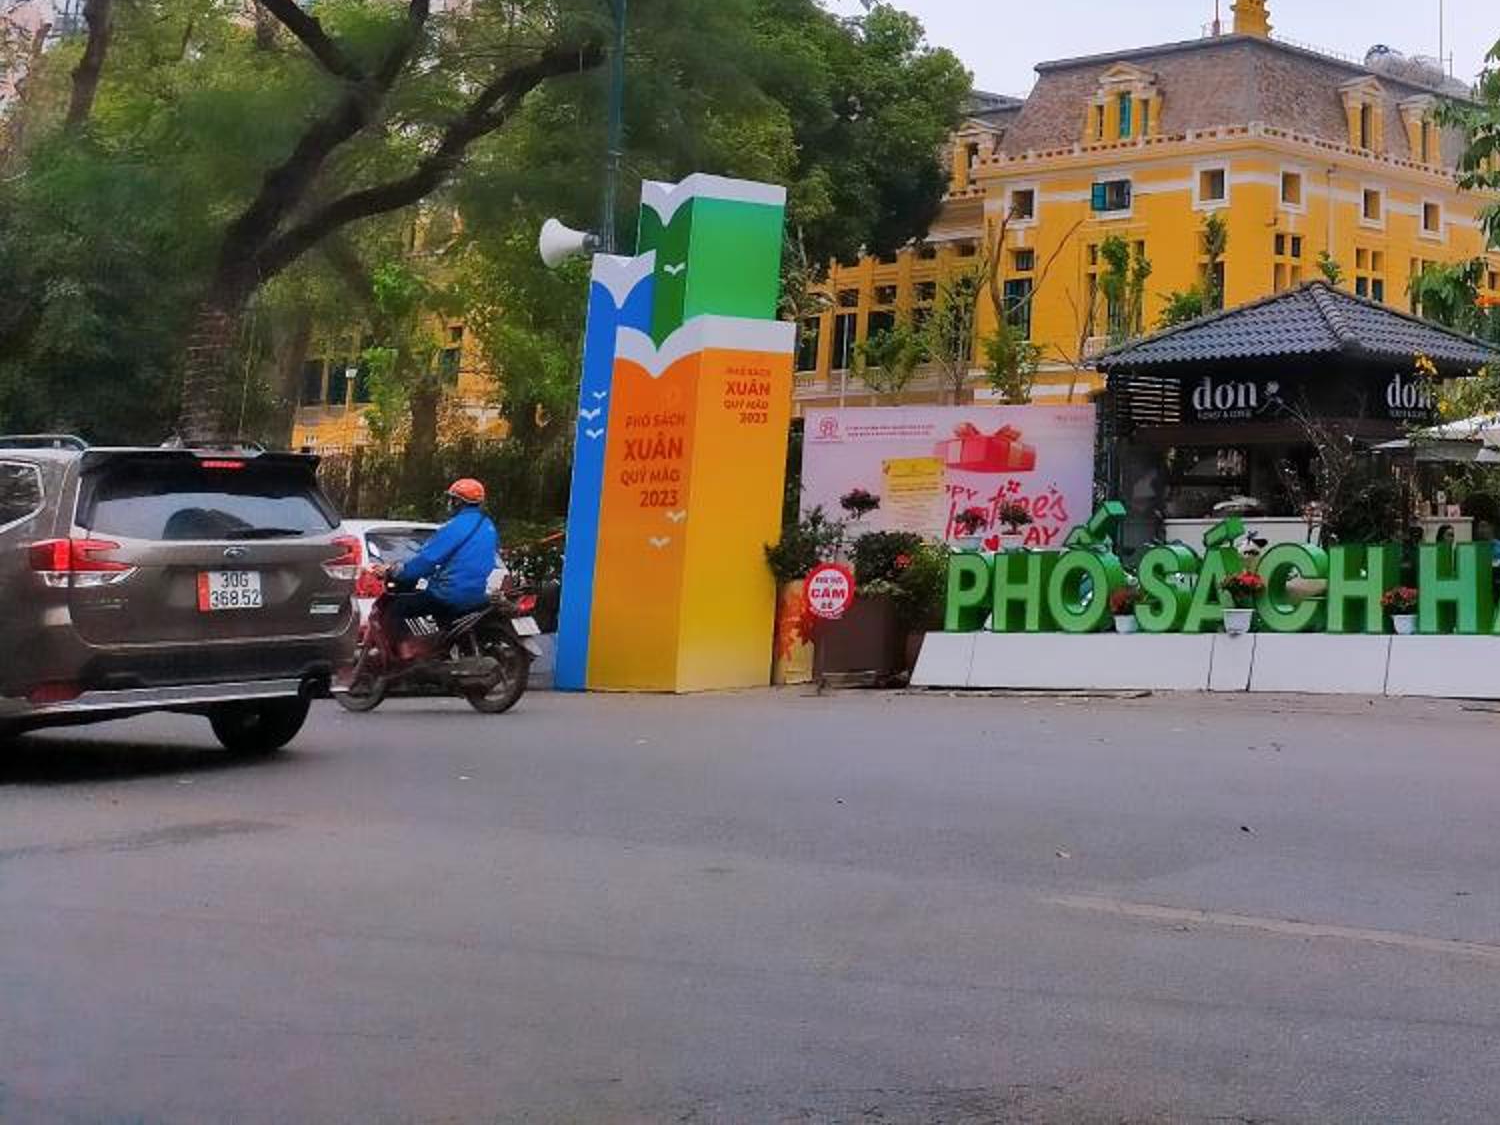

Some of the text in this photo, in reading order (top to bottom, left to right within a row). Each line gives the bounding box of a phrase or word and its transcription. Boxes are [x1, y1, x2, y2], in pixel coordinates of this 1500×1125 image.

[739, 412, 769, 424] 2023
[624, 430, 683, 460] XUÂN
[639, 490, 679, 508] 2023
[944, 501, 1128, 634] PHỐ
[1134, 516, 1398, 634] SÁCH
[221, 572, 249, 588] 30G
